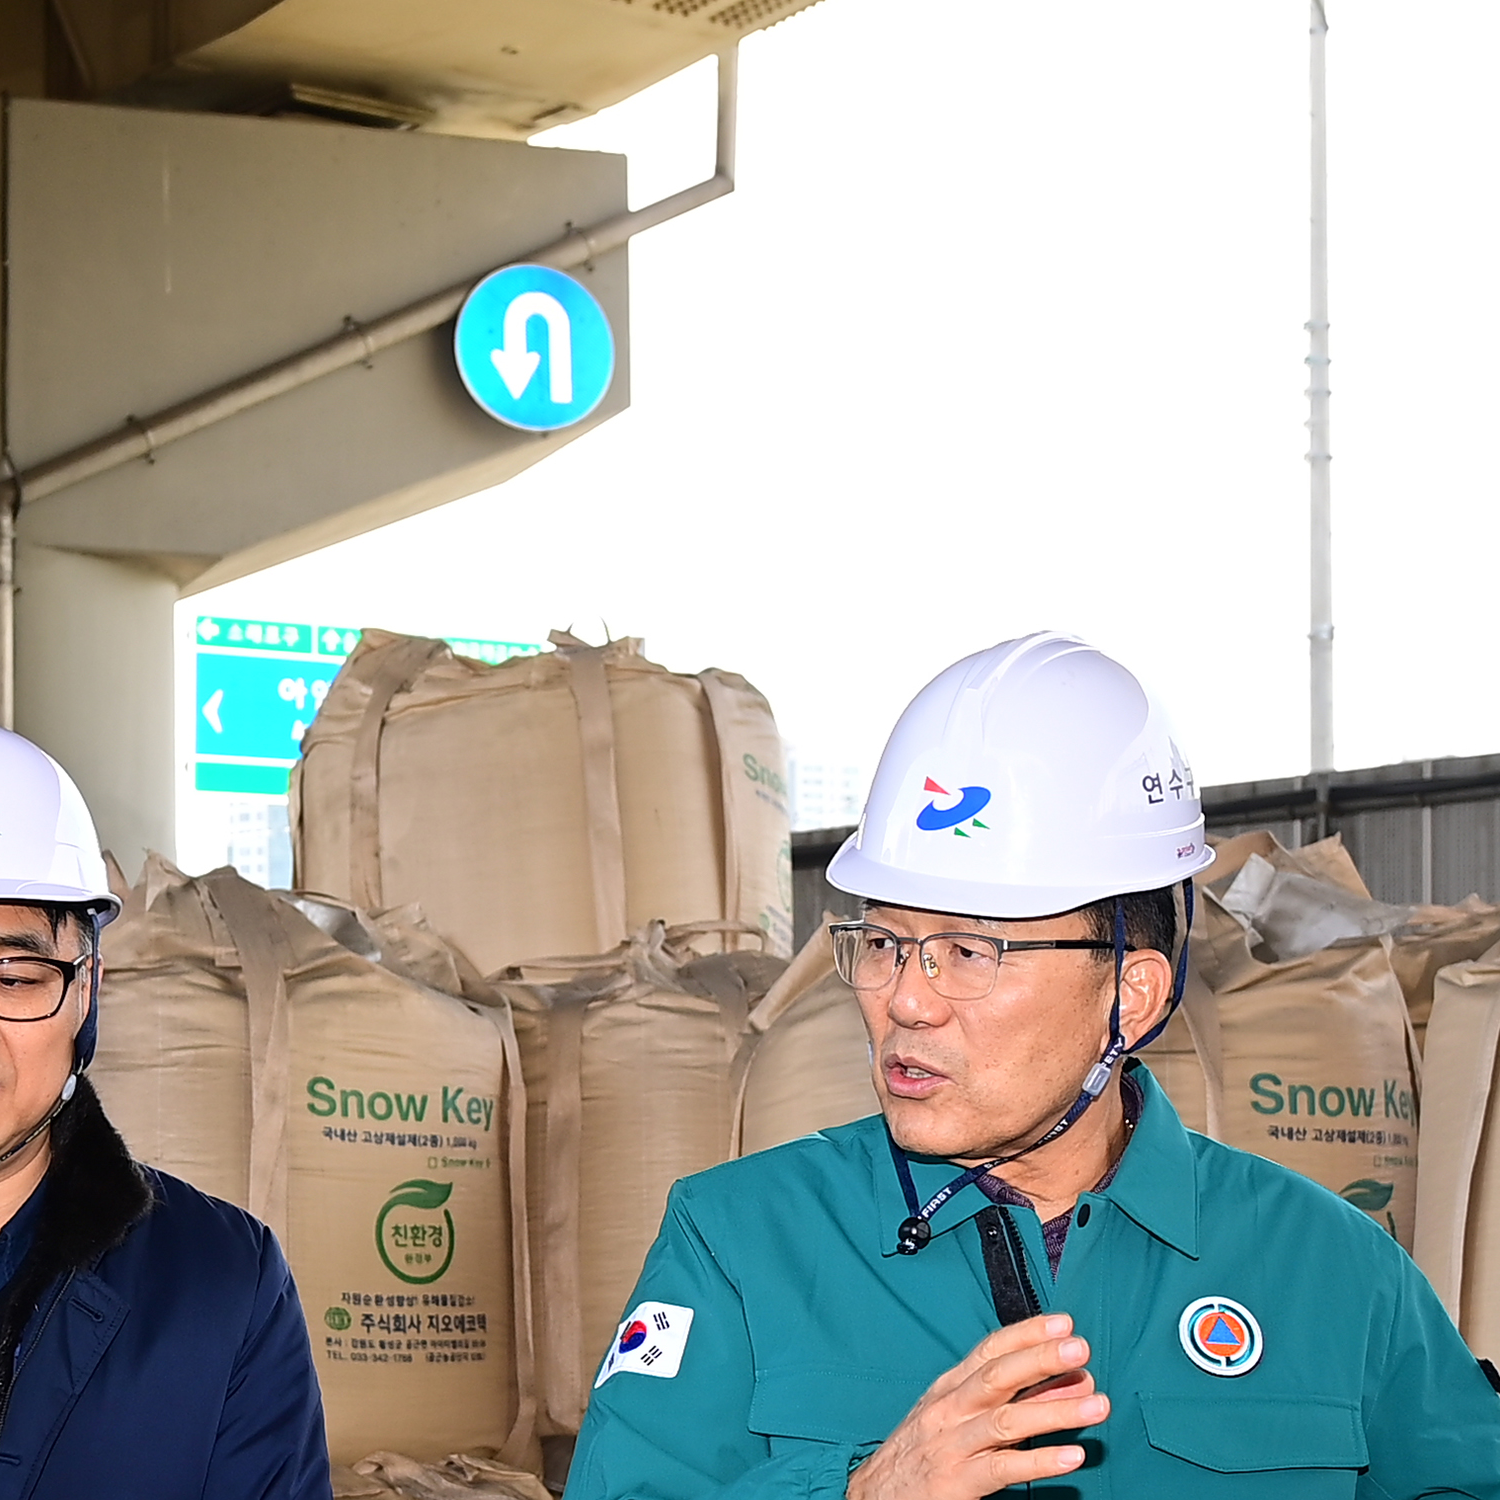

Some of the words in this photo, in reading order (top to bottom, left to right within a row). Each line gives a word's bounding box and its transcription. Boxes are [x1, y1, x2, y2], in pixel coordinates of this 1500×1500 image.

[306, 1076, 428, 1122] Snow
[441, 1086, 494, 1132] Key
[1249, 1072, 1376, 1117] Snow
[322, 1126, 358, 1143] 국내산
[1268, 1124, 1308, 1142] 국내산
[391, 1223, 443, 1248] 친환경
[361, 1313, 422, 1335] 주식회사
